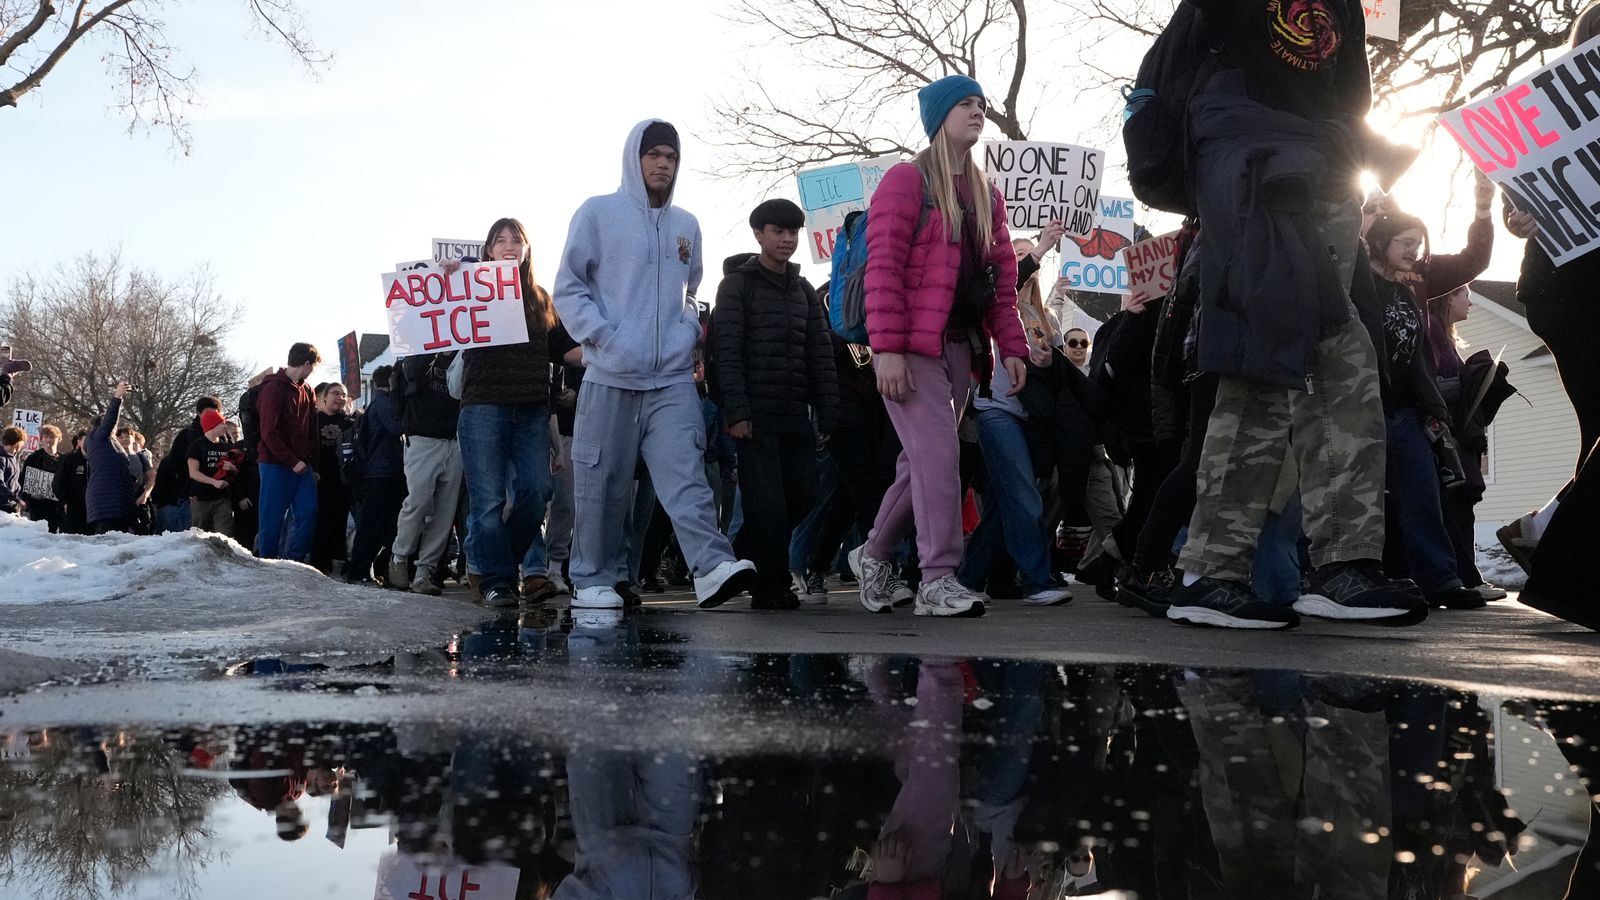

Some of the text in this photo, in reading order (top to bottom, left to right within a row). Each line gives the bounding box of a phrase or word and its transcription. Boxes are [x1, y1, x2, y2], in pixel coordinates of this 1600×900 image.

[1441, 83, 1561, 174] LOVE
[986, 144, 1097, 181] NO ONE IS
[816, 176, 843, 202] ICE
[988, 176, 1099, 211] LEGAL ON
[1006, 204, 1093, 236] TOLEN LAND
[1099, 198, 1135, 219] WAS
[813, 227, 842, 259] RE
[1126, 236, 1177, 270] HAND
[385, 266, 521, 308] ABOLISH
[1061, 261, 1131, 290] GOOD
[1130, 261, 1177, 292] MY S
[420, 305, 492, 350] ICE
[15, 410, 23, 420] I
